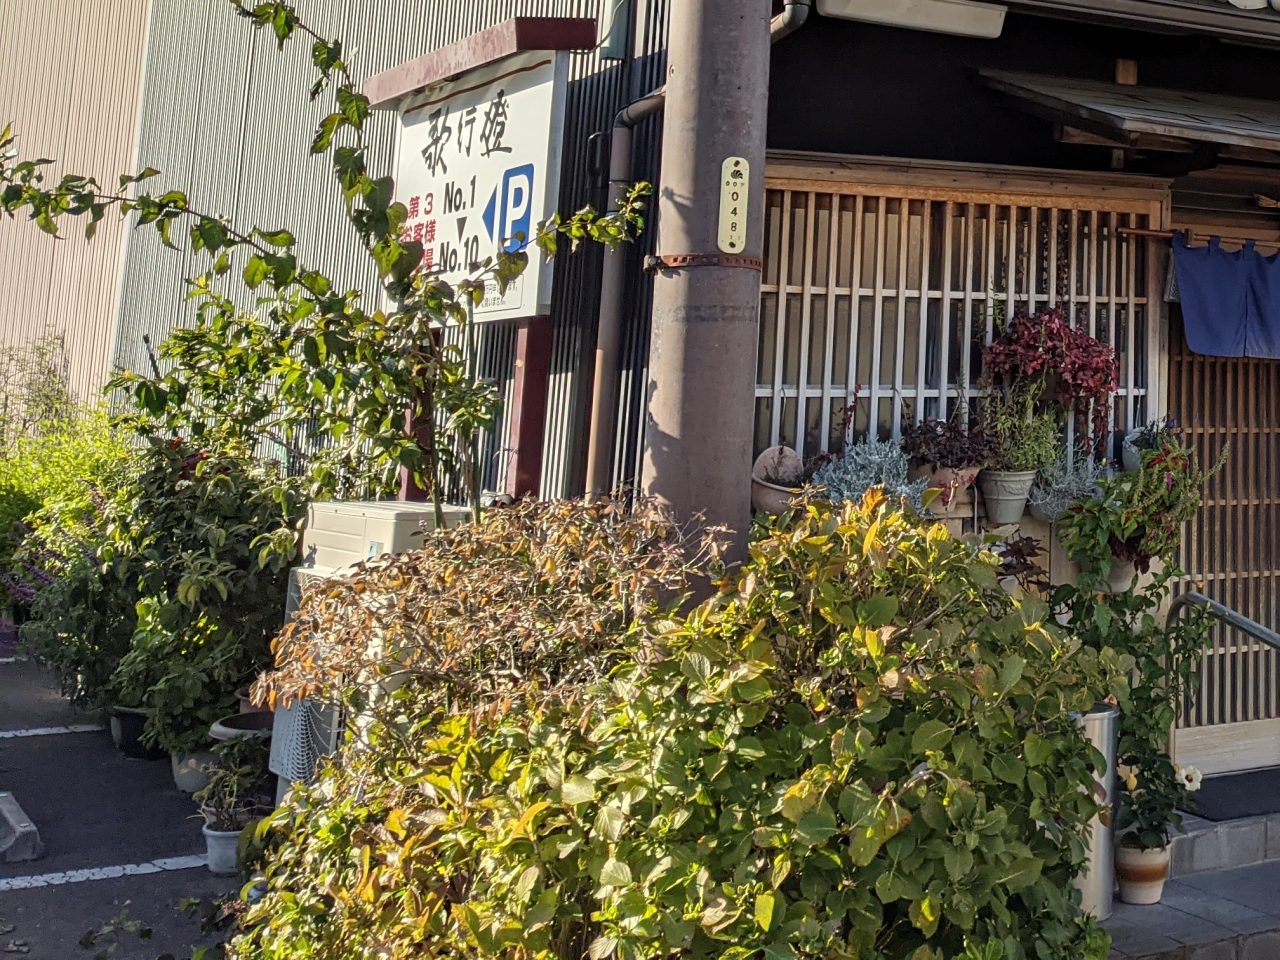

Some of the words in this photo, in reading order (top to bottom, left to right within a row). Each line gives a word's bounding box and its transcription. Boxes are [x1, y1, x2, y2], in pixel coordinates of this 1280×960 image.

[443, 175, 477, 215] No.1
[504, 174, 530, 249] P
[440, 235, 480, 273] No.10
